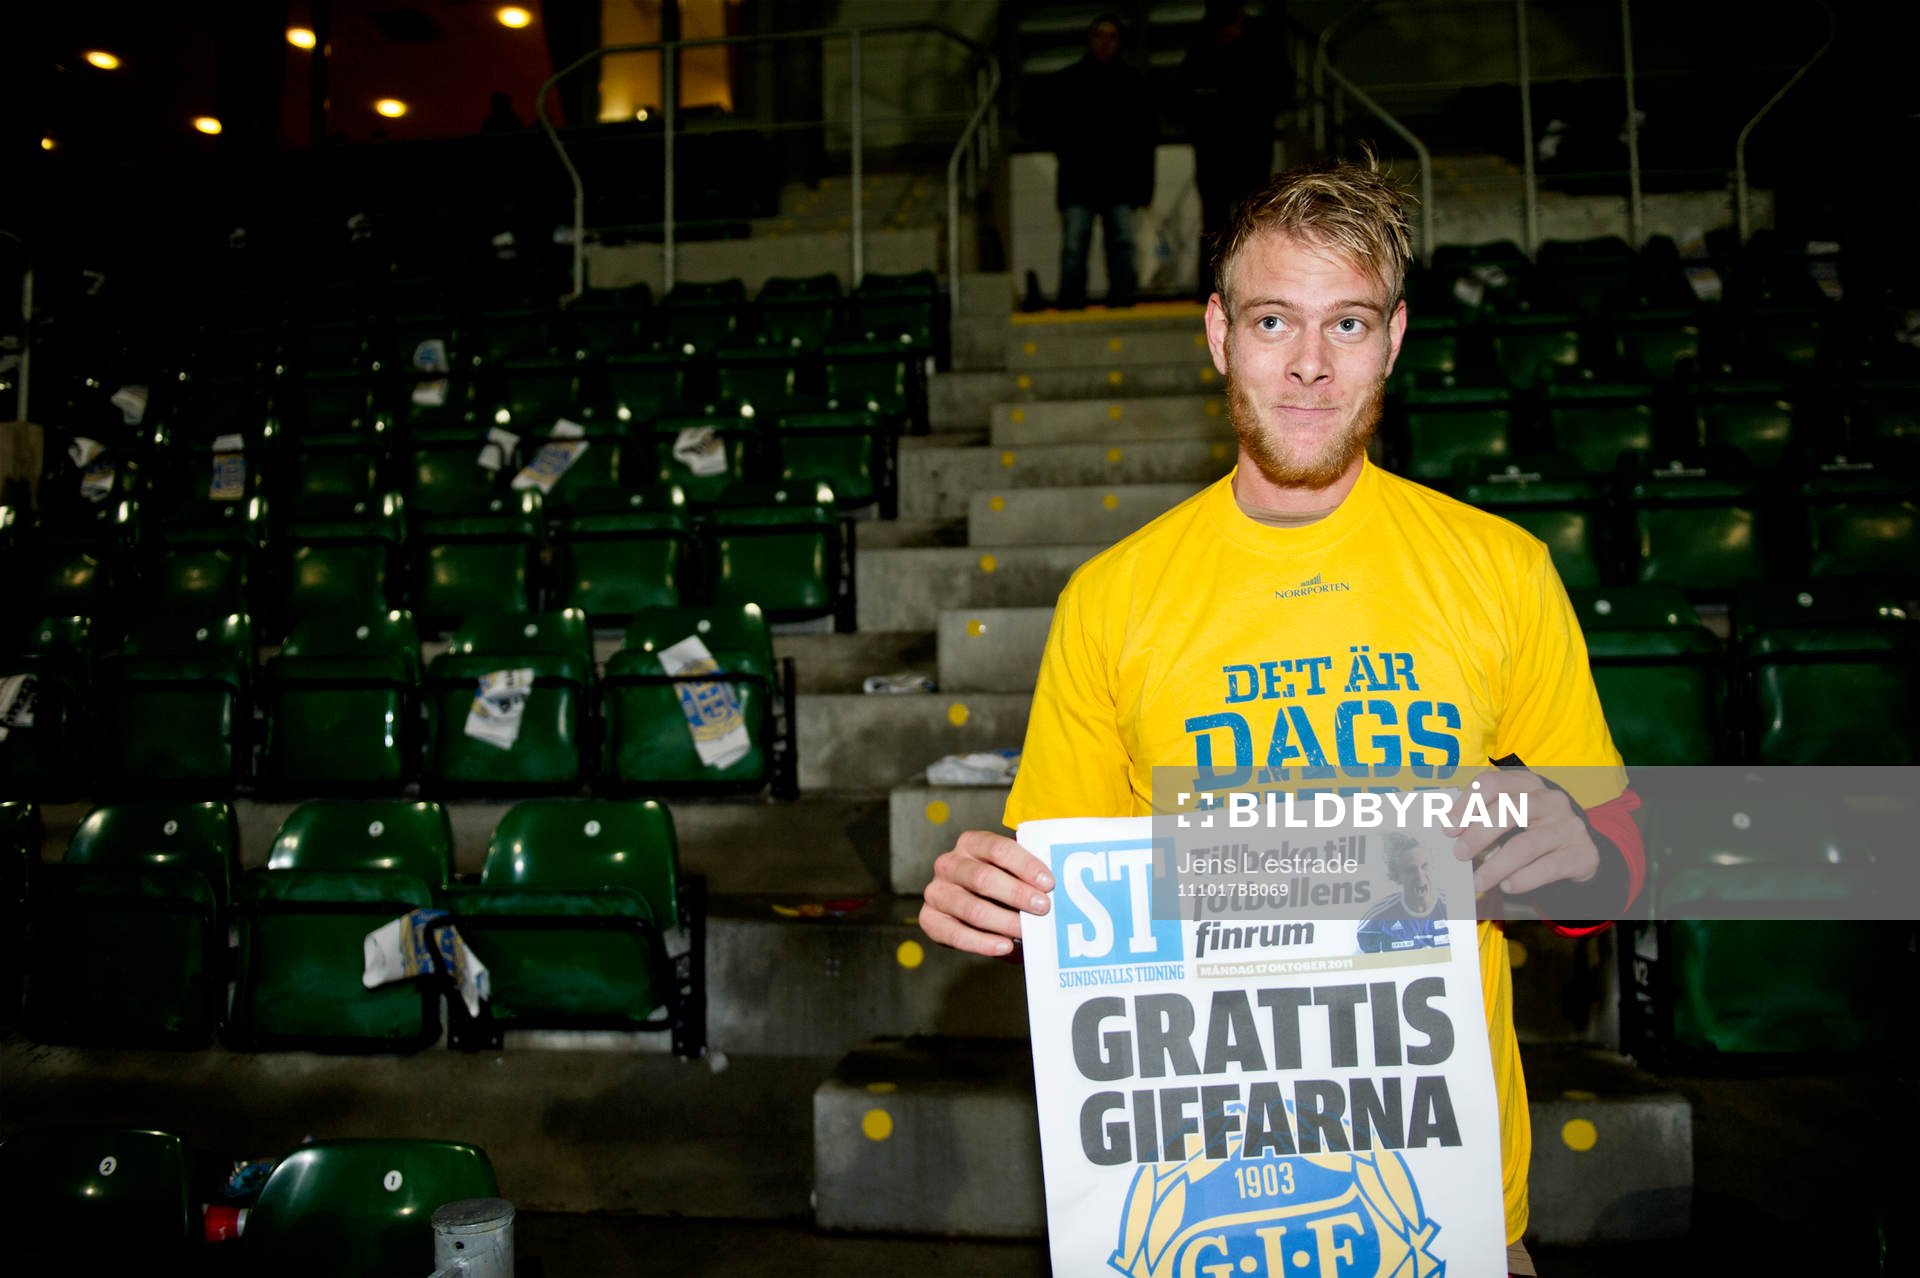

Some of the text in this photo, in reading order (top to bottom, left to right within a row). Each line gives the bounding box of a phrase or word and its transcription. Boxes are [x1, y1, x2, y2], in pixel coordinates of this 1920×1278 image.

[1275, 582, 1350, 600] NORRPORTEN
[1222, 645, 1420, 704] DET ÄR
[1184, 700, 1462, 792] DAGS
[1190, 835, 1366, 876] Tillbaka till
[1063, 848, 1167, 958] ST
[1193, 876, 1372, 922] fotbollens
[1195, 920, 1315, 958] finrum
[1059, 965, 1185, 989] SUNDSVALLS TIDNING
[1200, 959, 1353, 977] MÅNDAG 17 OKTOBER 2011
[1071, 976, 1455, 1082] GRATTIS
[1079, 1075, 1463, 1166] GIFFARNA
[1234, 1162, 1296, 1200] 1903
